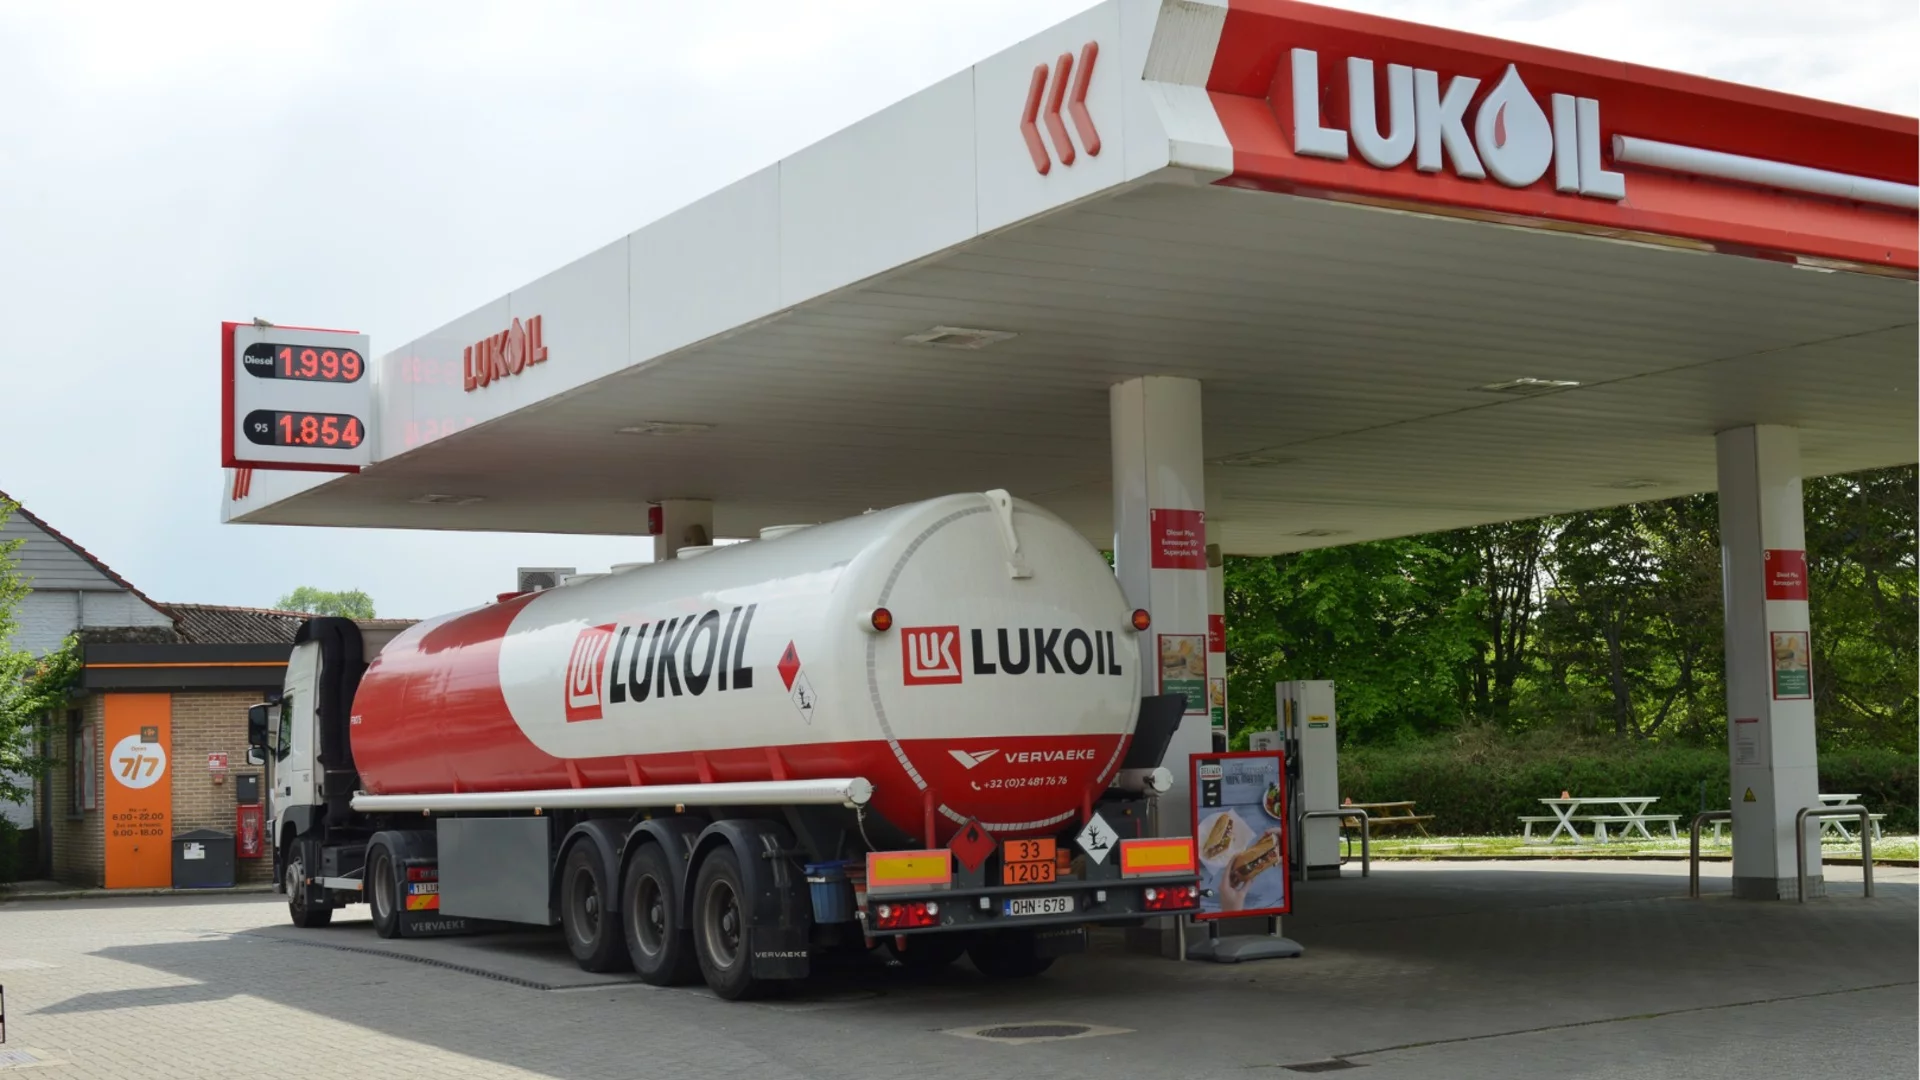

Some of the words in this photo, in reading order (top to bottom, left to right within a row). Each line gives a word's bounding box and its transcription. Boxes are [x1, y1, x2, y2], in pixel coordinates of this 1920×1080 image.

[1291, 47, 1626, 200] LUKOIL
[244, 355, 274, 366] Diesel
[279, 347, 361, 380] 1.999
[463, 314, 548, 393] LUKOIL
[254, 423, 269, 433] 95
[279, 414, 360, 447] 1.854
[1151, 510, 1157, 521] 1
[1199, 512, 1205, 524] 2
[1764, 551, 1771, 560] 3
[609, 603, 757, 704] LUKOIL
[908, 631, 960, 678] LUK
[970, 628, 1122, 676] LUKOIL
[1005, 749, 1096, 763] VERVAEKE
[118, 755, 160, 780] 7/7
[984, 779, 1003, 789] +32
[1004, 778, 1026, 789] (0)2
[1027, 777, 1044, 787] 481
[1045, 776, 1056, 786] 76
[1058, 776, 1068, 785] 76
[1020, 842, 1040, 859] 33
[1009, 863, 1050, 882] 1203
[411, 920, 466, 931] VERVAEKE
